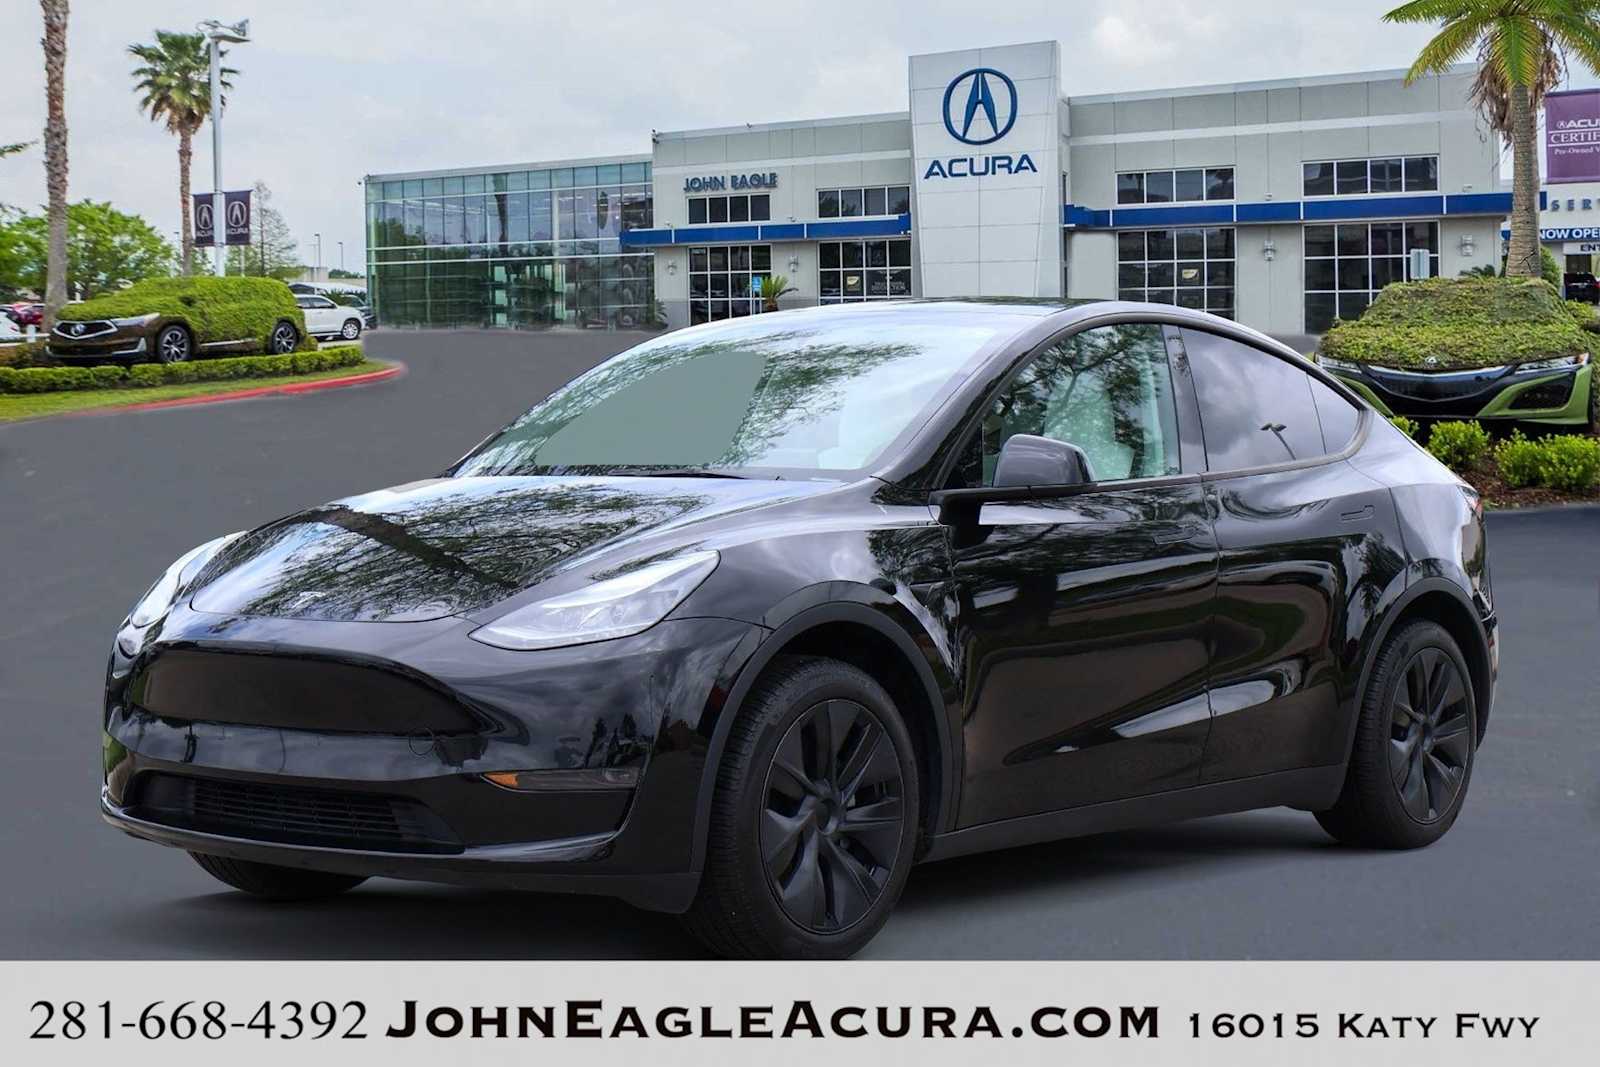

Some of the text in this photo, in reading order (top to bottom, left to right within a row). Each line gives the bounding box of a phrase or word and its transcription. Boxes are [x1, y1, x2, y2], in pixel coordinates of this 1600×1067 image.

[1567, 118, 1600, 129] ACU
[923, 153, 1038, 180] ACURA
[684, 172, 778, 192] JOHN EAGLE
[1551, 198, 1600, 212] SER
[1572, 228, 1600, 239] OPE
